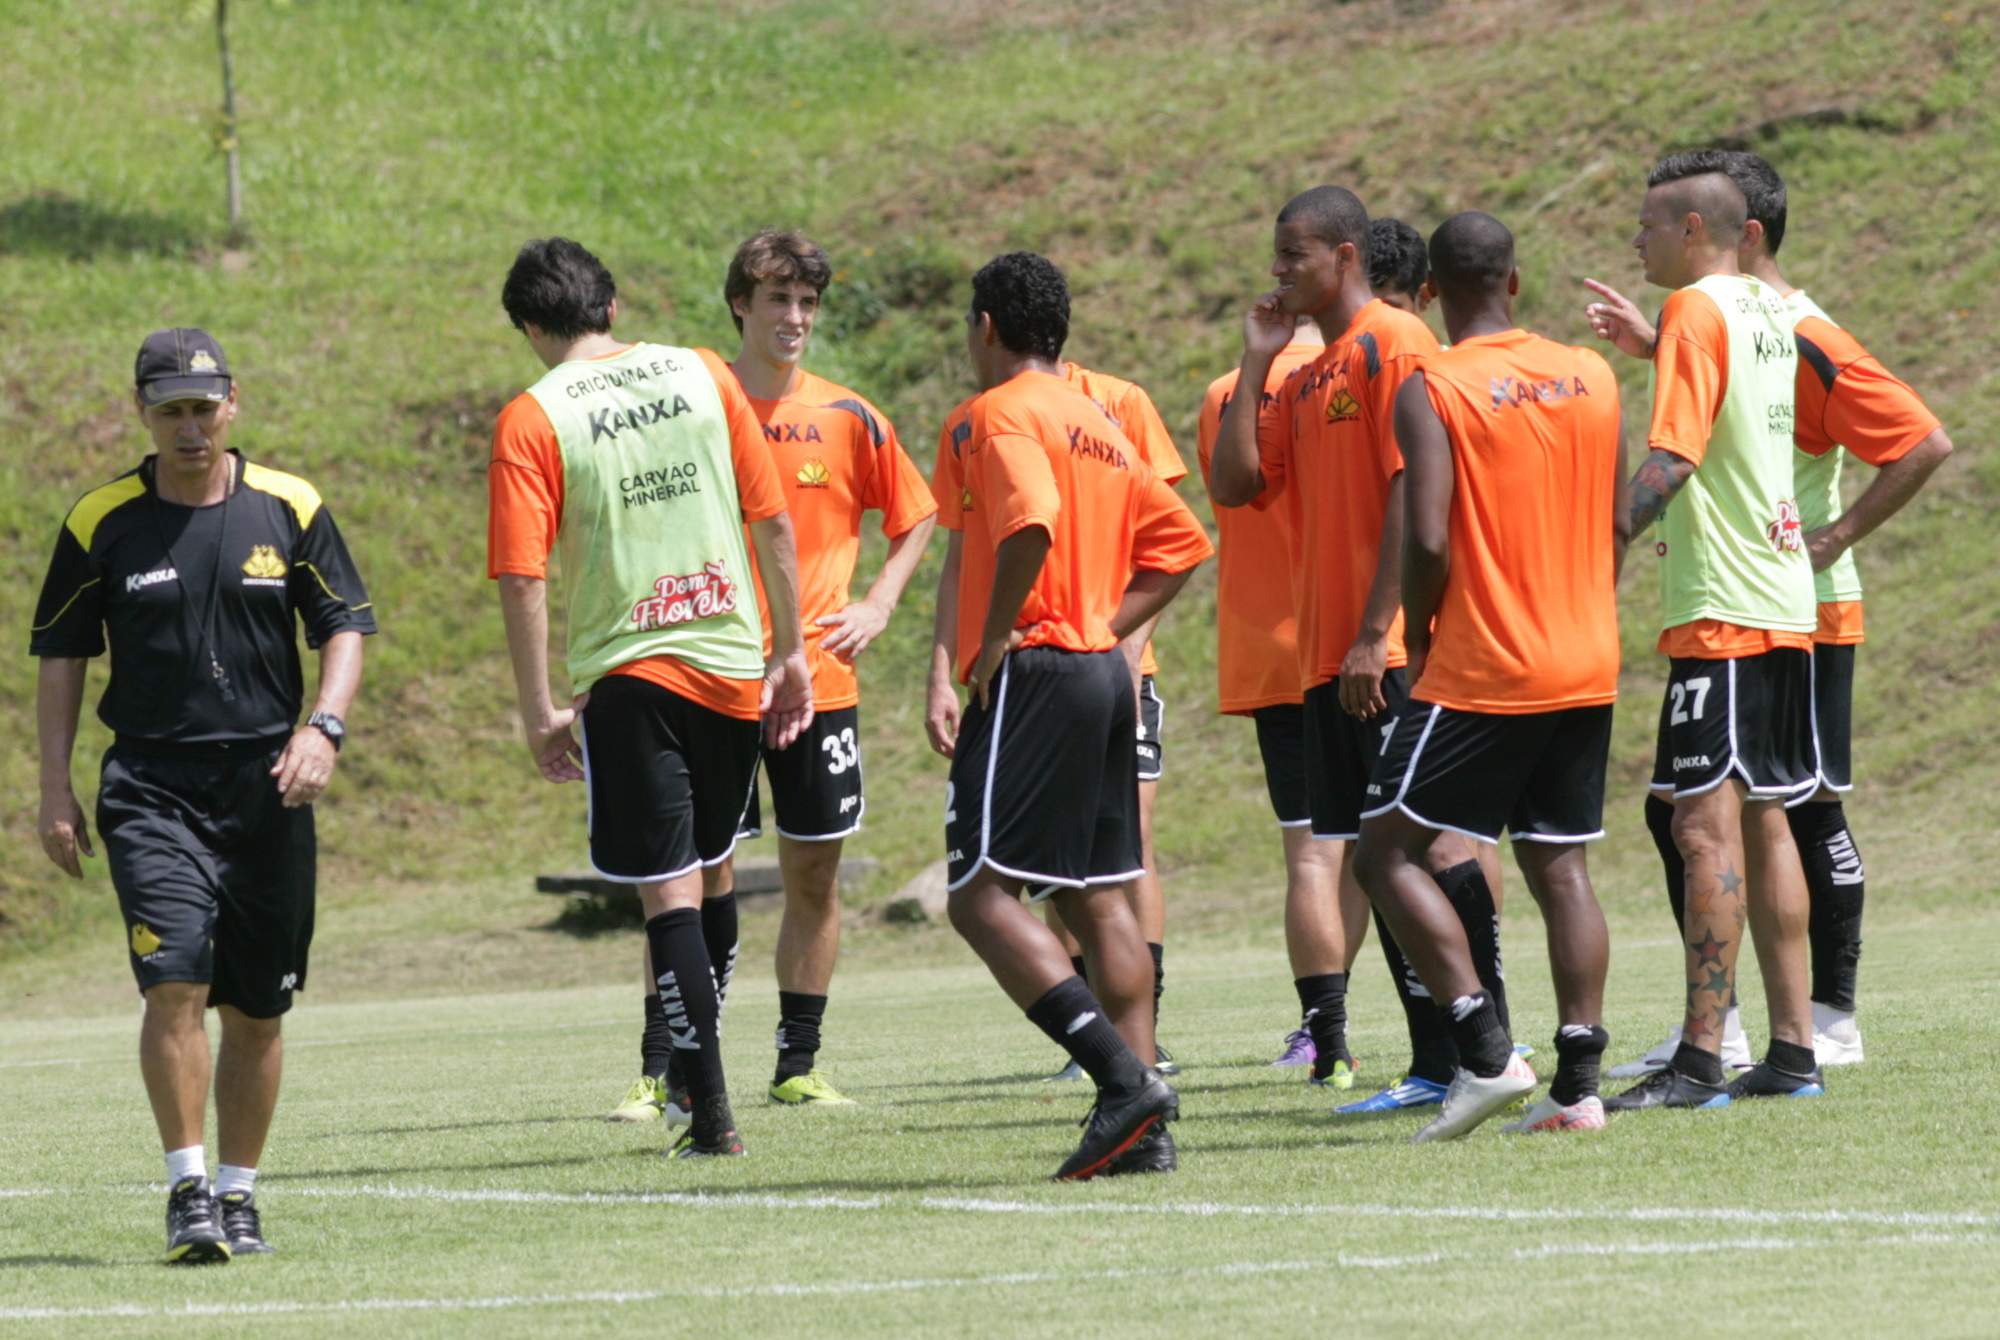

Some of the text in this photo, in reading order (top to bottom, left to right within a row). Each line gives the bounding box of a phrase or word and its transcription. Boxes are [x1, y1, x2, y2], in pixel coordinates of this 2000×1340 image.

[649, 359, 684, 376] E.C.
[588, 394, 692, 444] KANXA
[761, 423, 823, 444] NXA
[1064, 424, 1130, 471] KANXA
[623, 479, 702, 509] MINERAL
[126, 567, 178, 593] KANXA
[1671, 676, 1712, 727] 27
[822, 727, 857, 775] 33
[657, 969, 701, 1050] KANXA
